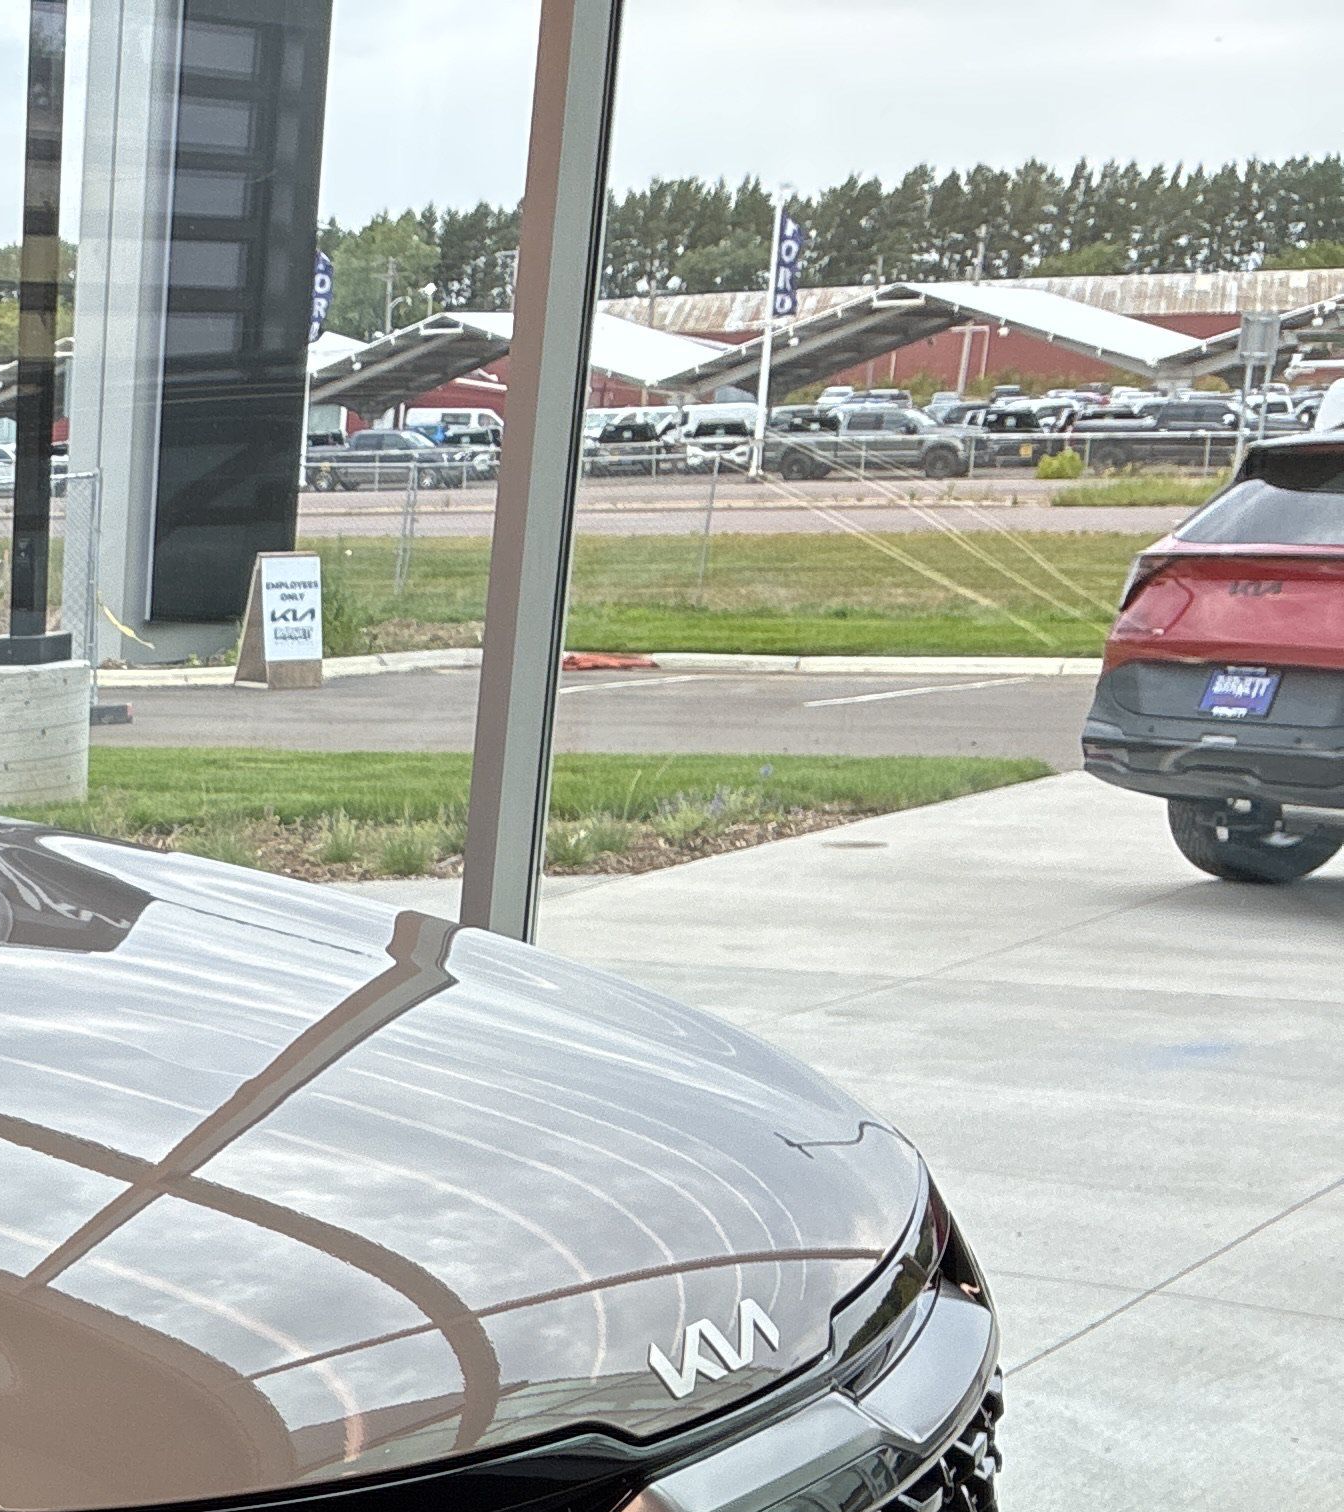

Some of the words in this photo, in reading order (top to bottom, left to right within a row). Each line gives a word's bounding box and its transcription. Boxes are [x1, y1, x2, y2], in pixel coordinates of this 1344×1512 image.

[308, 253, 332, 341] OR
[265, 581, 319, 590] EMPLOYEES
[280, 593, 305, 601] ONLY
[271, 608, 315, 622] KIA
[648, 1298, 780, 1400] KIA
